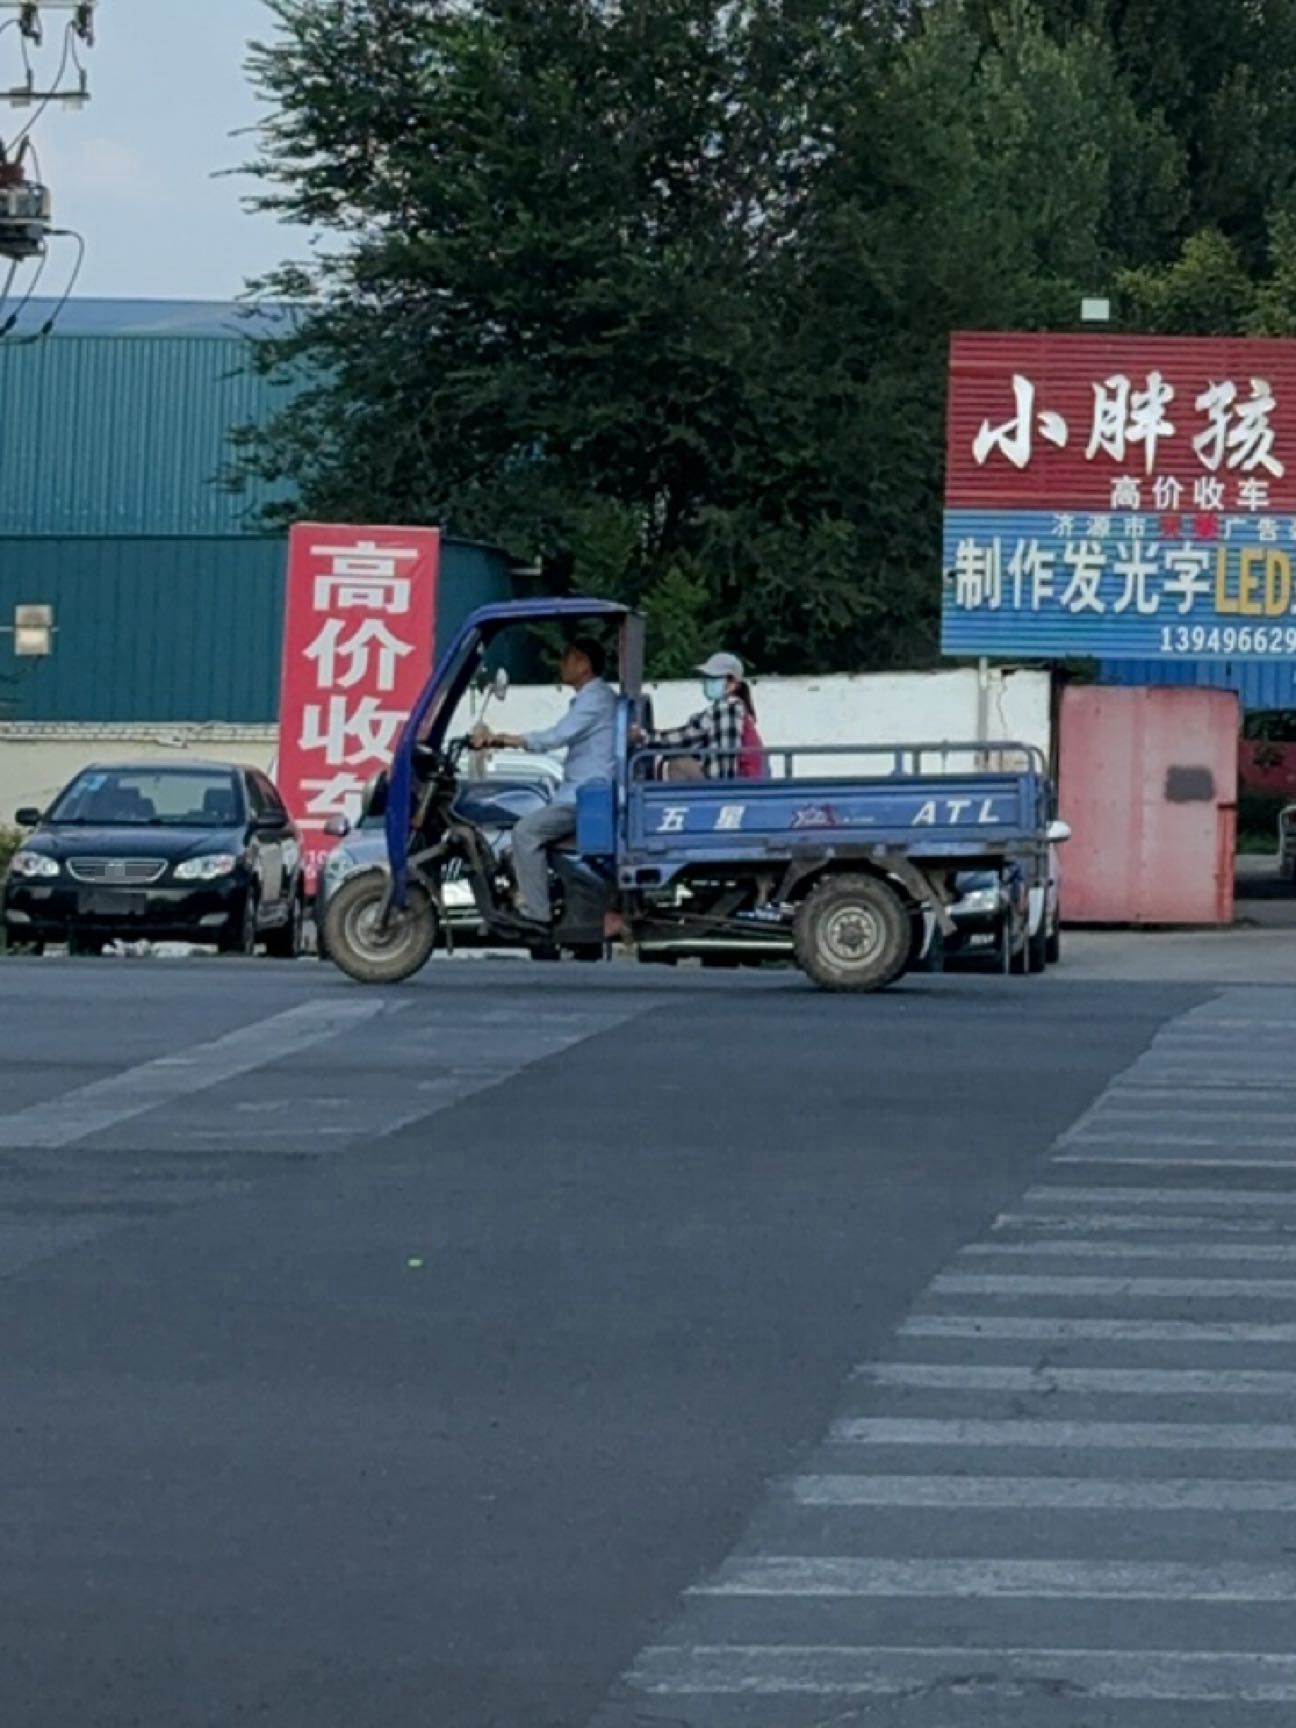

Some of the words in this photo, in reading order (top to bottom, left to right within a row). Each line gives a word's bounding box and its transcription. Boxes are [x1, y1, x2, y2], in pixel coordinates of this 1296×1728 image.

[1110, 475, 1270, 511] 高价收车
[656, 805, 746, 832] 五星
[912, 798, 1000, 826] ATL
